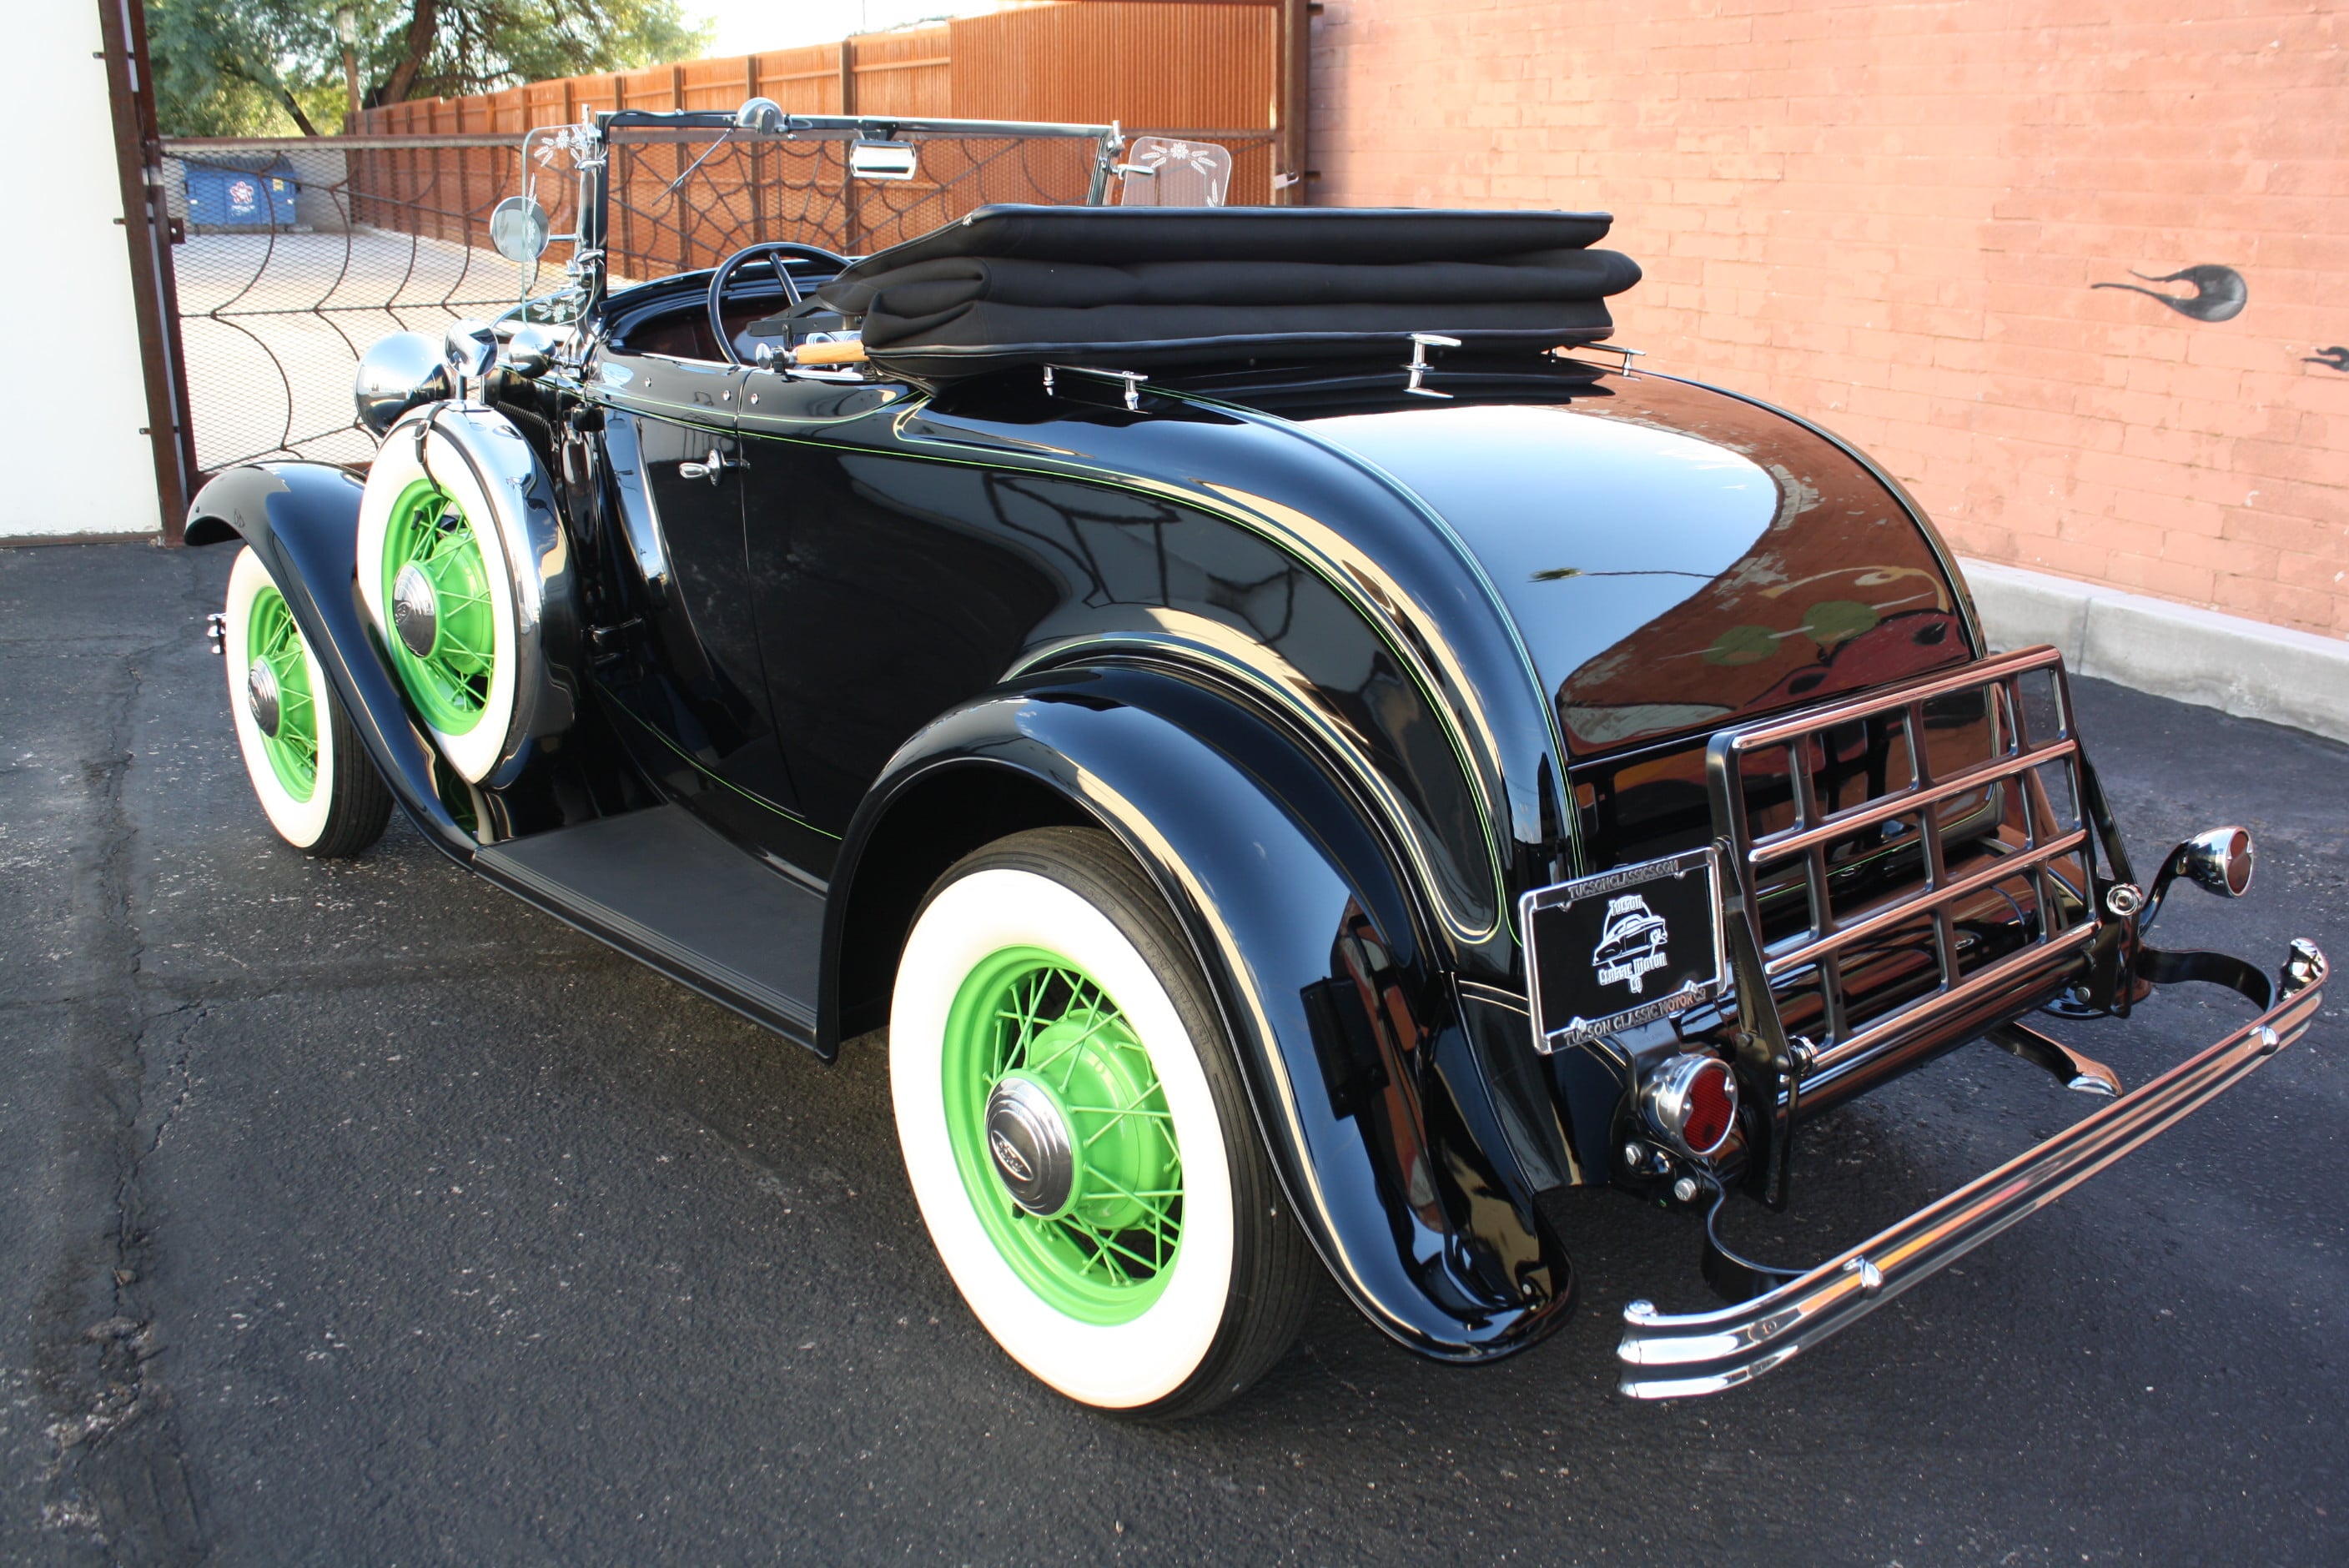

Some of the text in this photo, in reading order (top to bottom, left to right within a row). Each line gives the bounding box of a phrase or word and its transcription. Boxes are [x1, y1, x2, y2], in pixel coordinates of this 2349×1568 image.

[1568, 859, 1678, 899] TUCSONCLASSICS.COM
[1563, 1019, 1611, 1046] TUCSON
[1613, 1003, 1659, 1029] CLASSIC
[1659, 993, 1694, 1015] MOTOR
